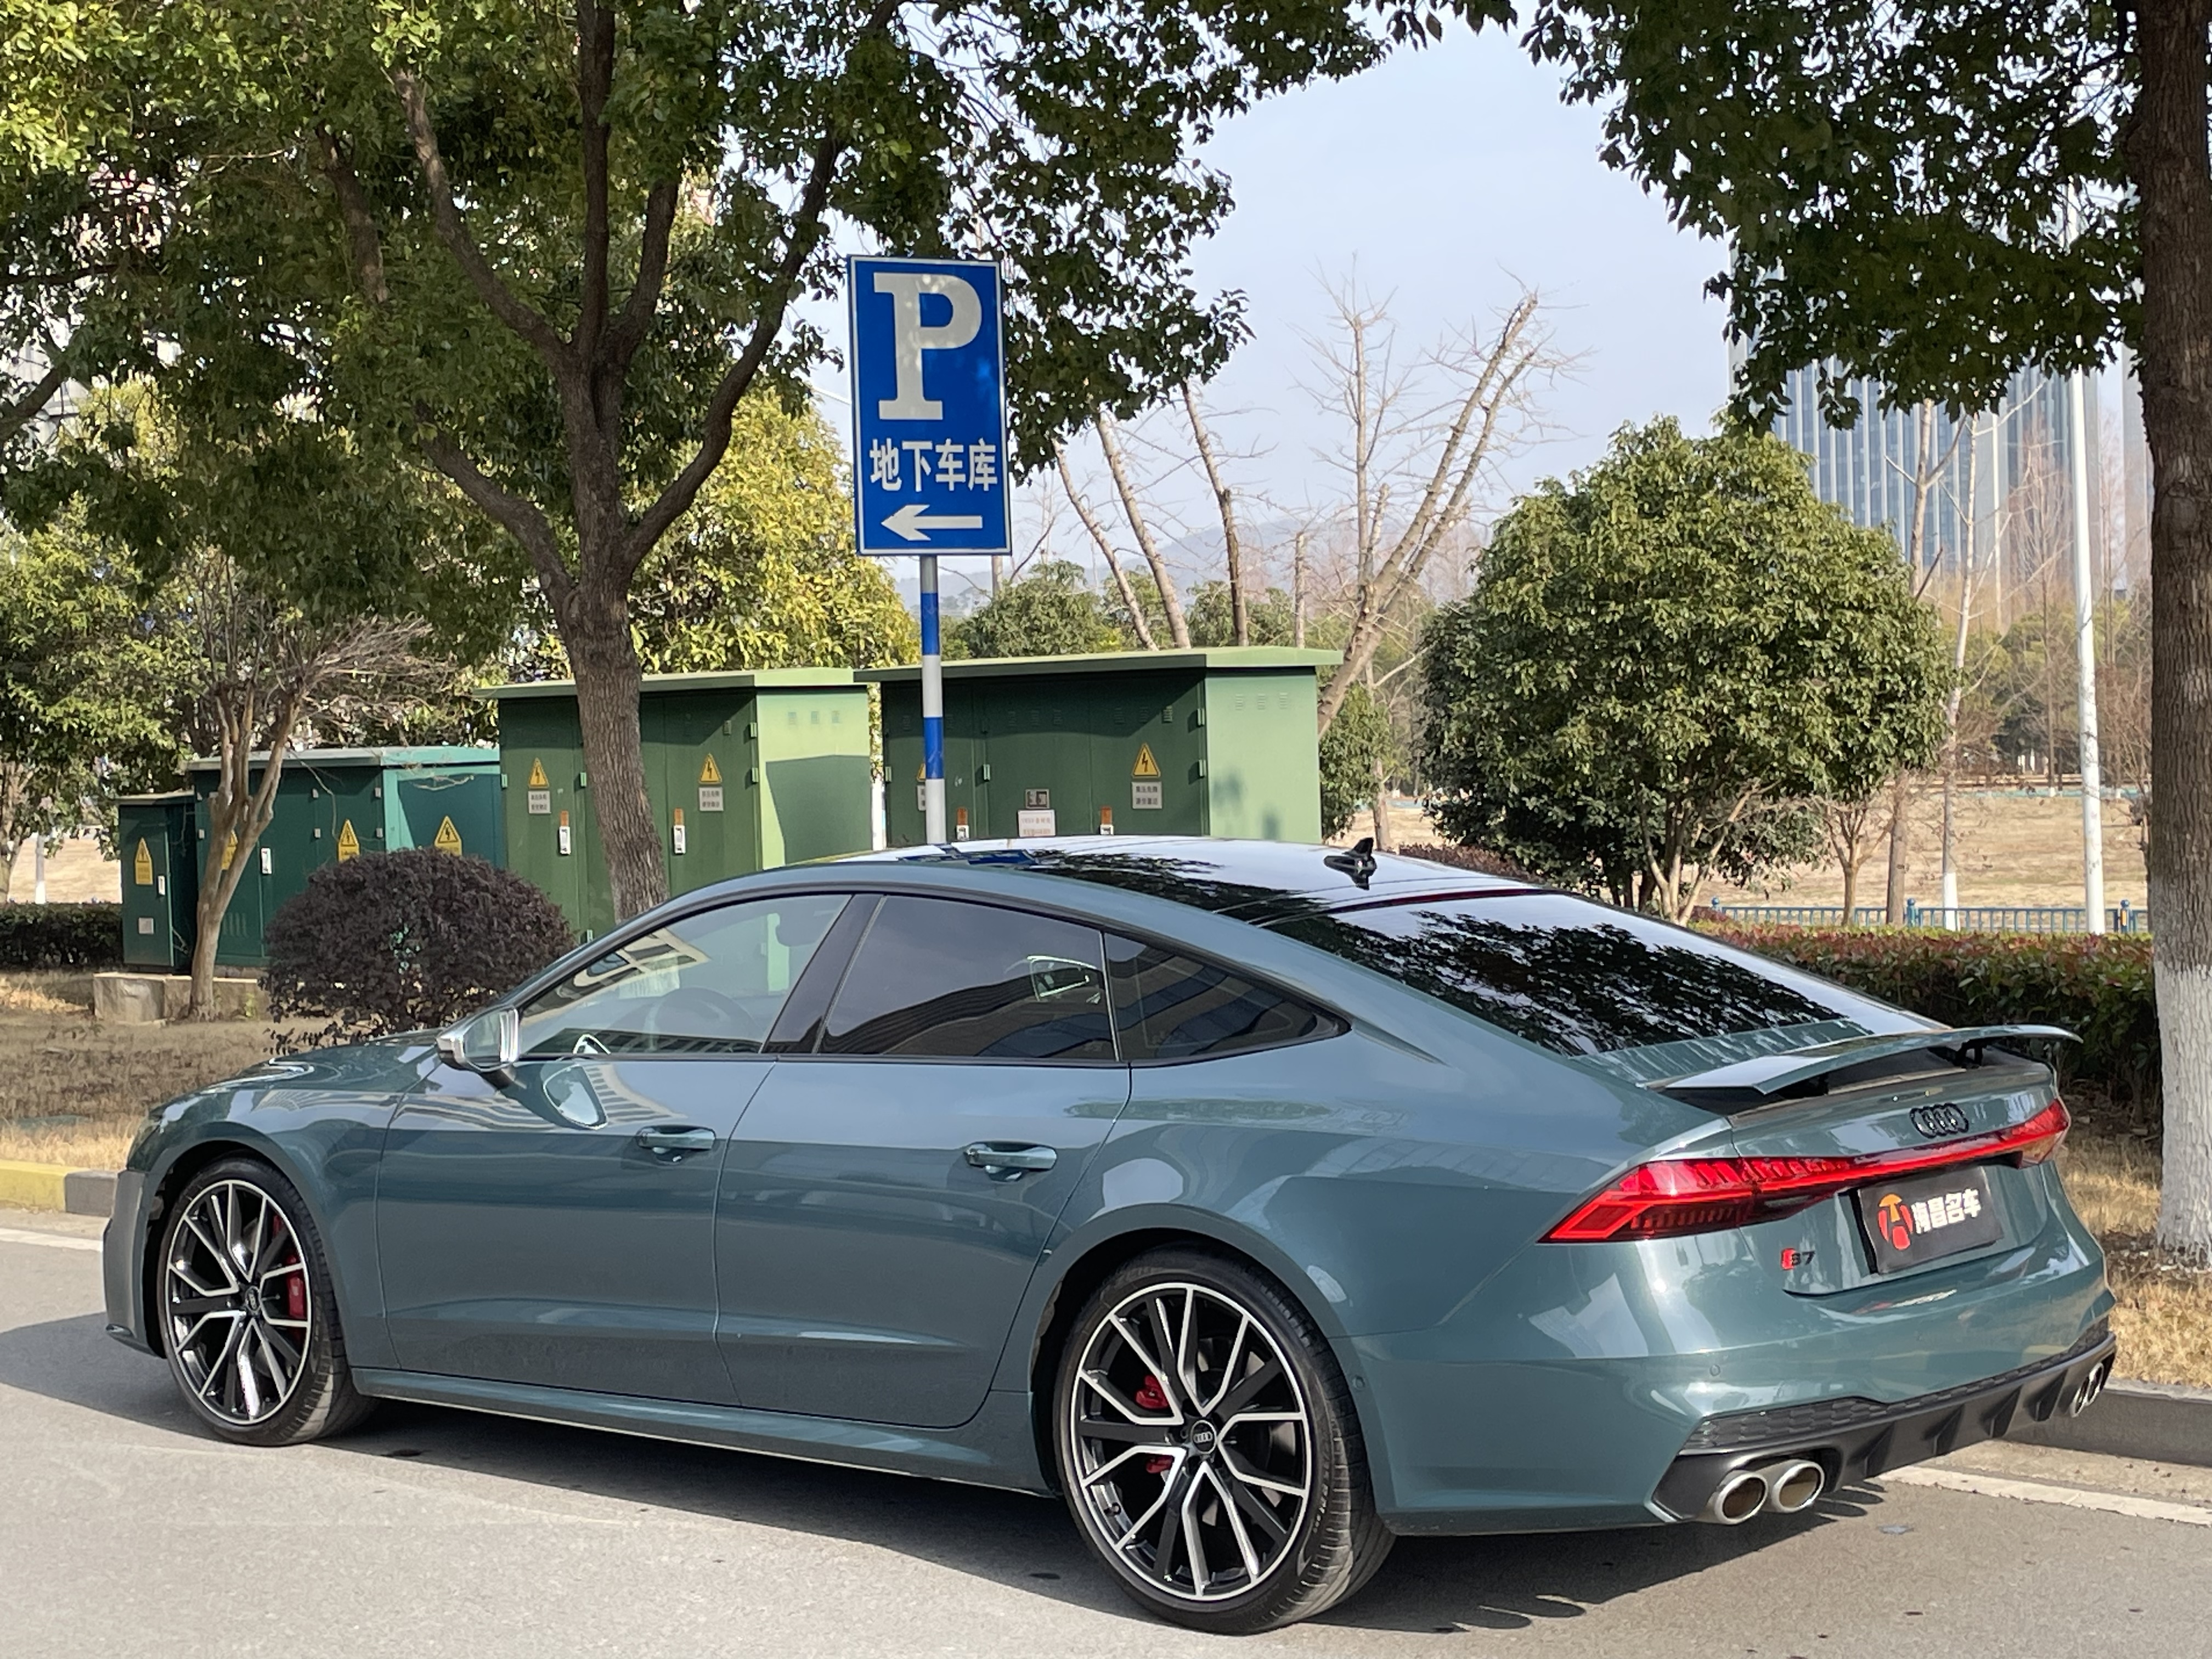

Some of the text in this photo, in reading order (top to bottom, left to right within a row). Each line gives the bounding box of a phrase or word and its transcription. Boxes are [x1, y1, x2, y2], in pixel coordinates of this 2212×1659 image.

[873, 272, 982, 420] P
[870, 438, 998, 492] 地下车库
[1788, 1250, 1816, 1266] S7
